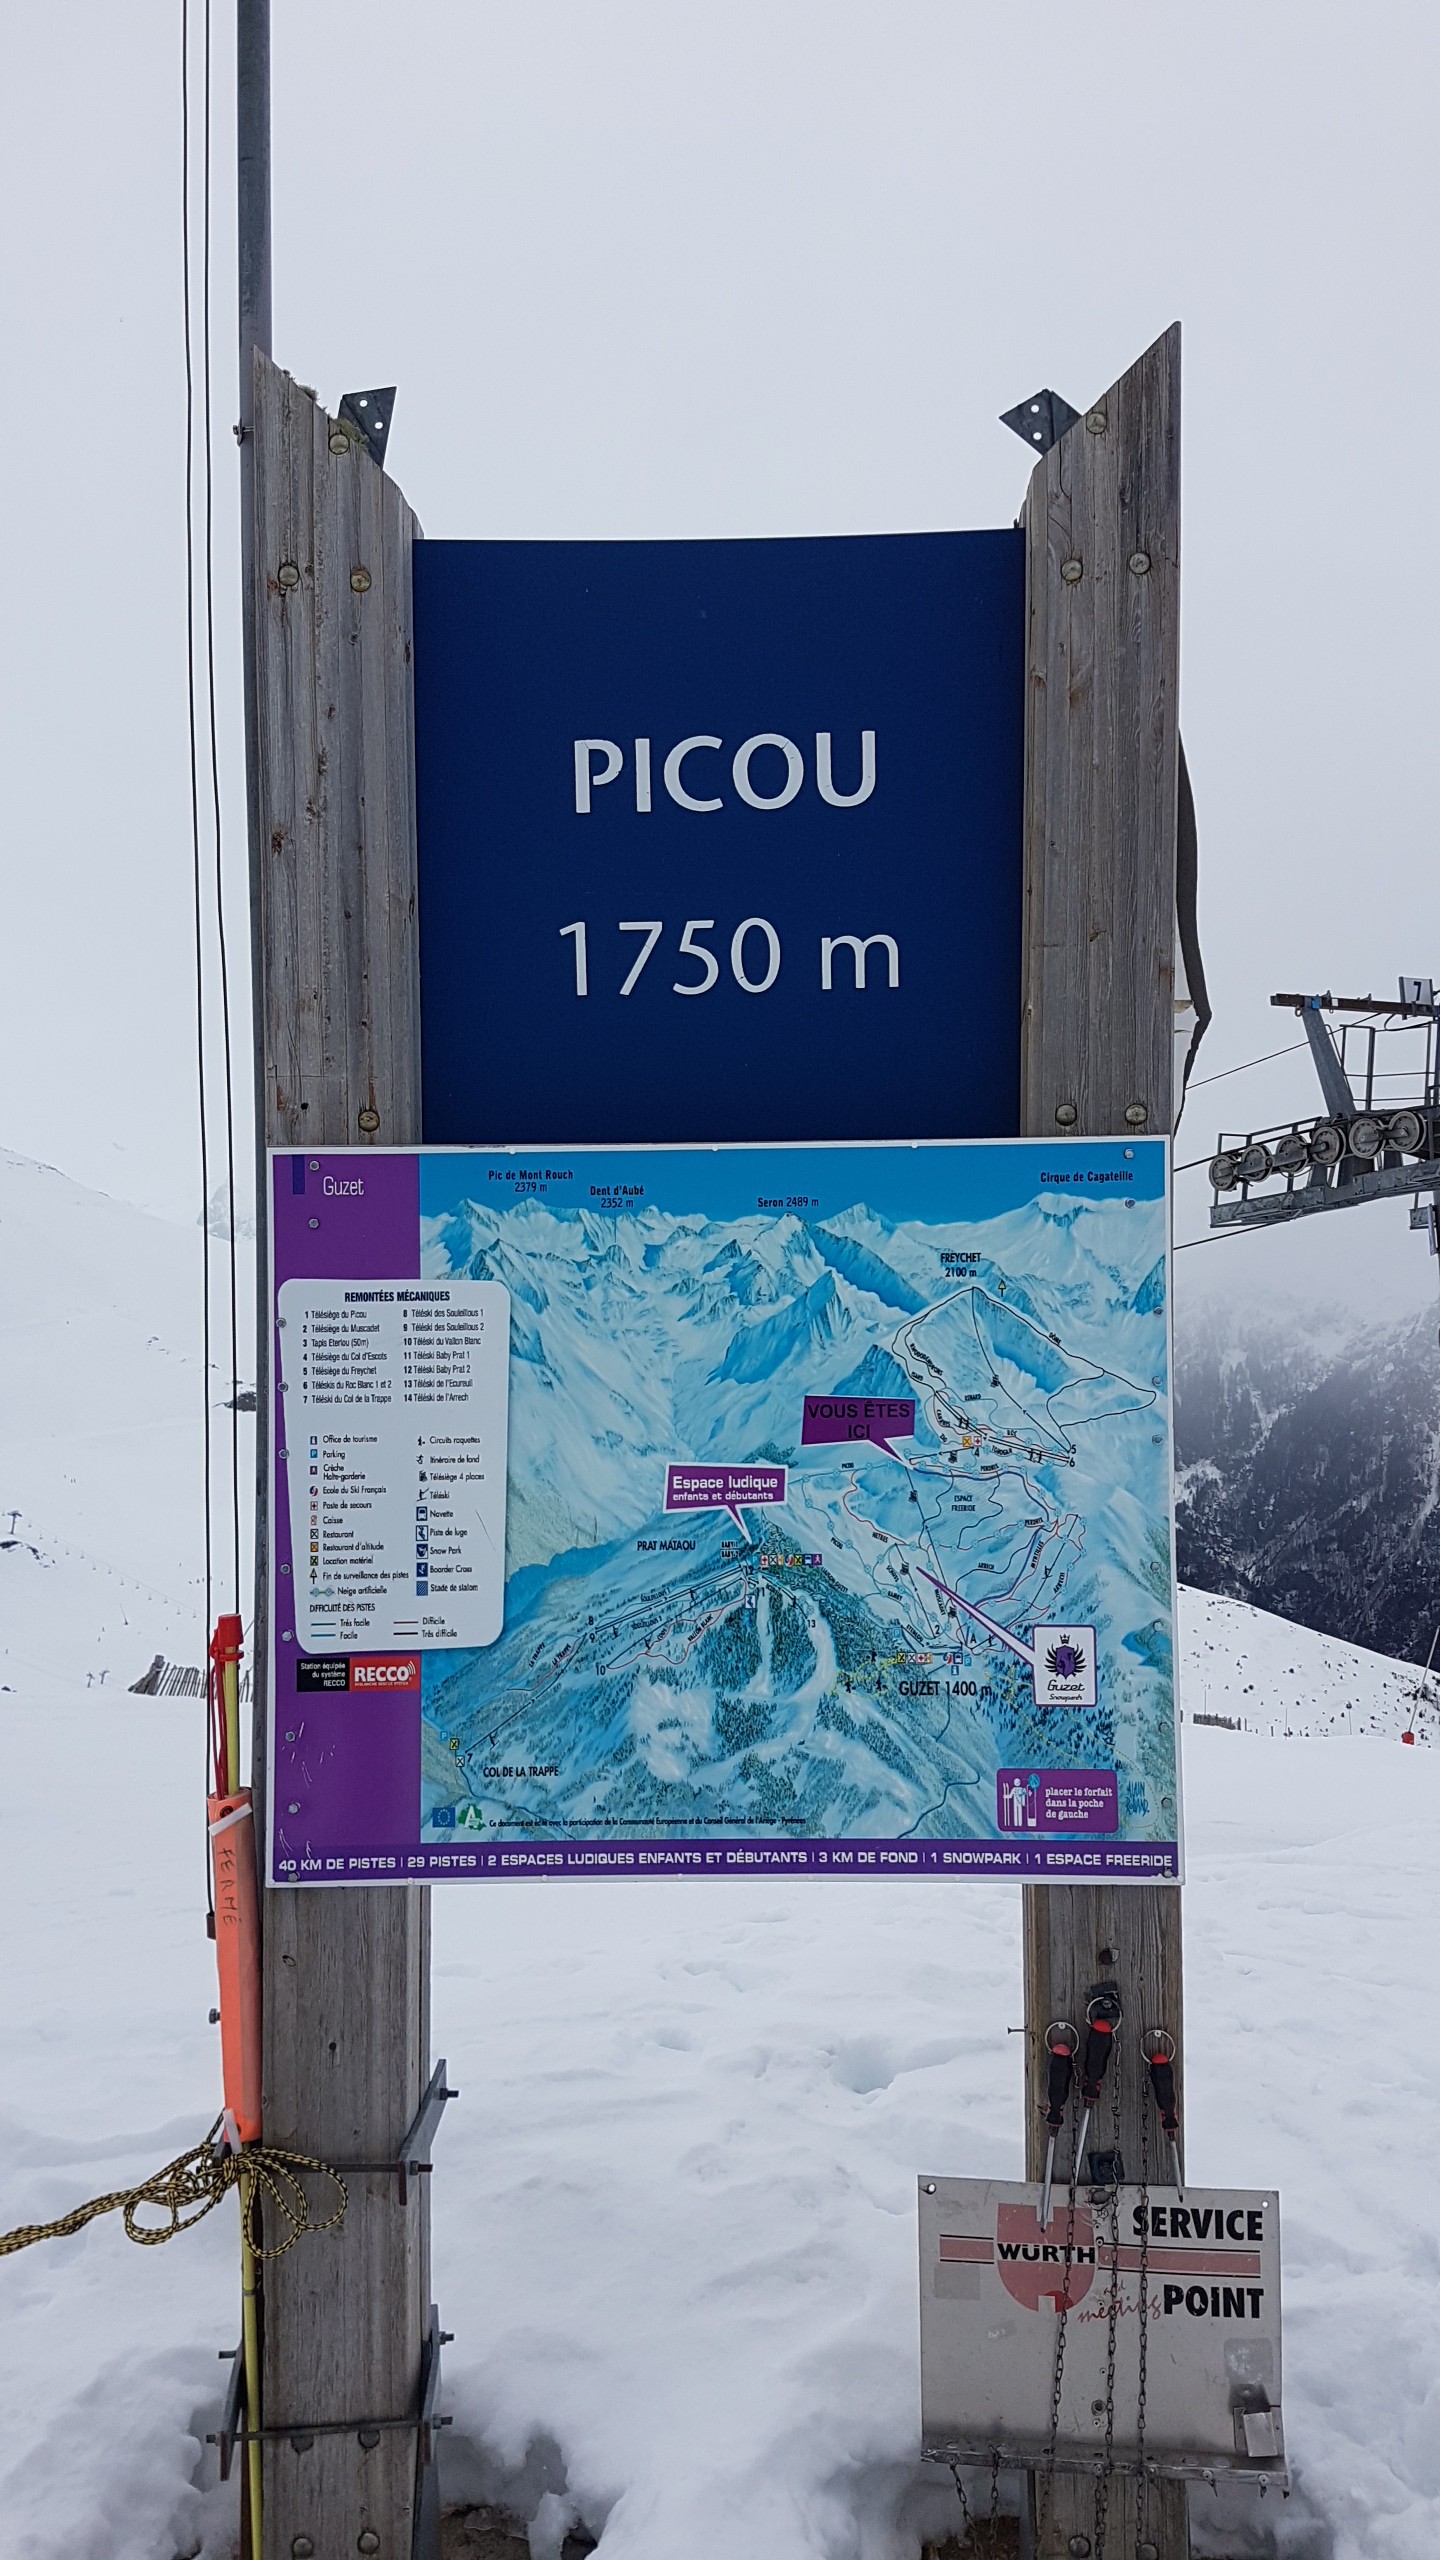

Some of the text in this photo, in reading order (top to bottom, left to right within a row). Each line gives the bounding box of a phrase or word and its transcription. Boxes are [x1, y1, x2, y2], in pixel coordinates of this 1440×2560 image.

[573, 730, 876, 814] PICOU
[559, 917, 900, 996] 1750 m
[1412, 981, 1422, 1002] 7
[488, 1169, 573, 1180] Pic de Mont Rouch
[1040, 1170, 1133, 1183] Cirque de Cagateille
[322, 1175, 365, 1197] Guzet
[514, 1182, 547, 1192] 2379 m
[590, 1184, 644, 1196] Dent d'Aubé
[601, 1197, 633, 1208] 2352 m
[757, 1196, 819, 1208] Seron 2489 m
[940, 1252, 981, 1264] FREYCHET
[945, 1267, 977, 1278] 2100 m
[344, 1289, 450, 1302] REMONTÉES MÉCANIQUES
[304, 1309, 367, 1320] 1 Télésiège du Picou
[302, 1323, 380, 1334] 2 Télésiège du Muscadet
[302, 1338, 308, 1347] 3
[311, 1338, 327, 1349] Tapis
[350, 1338, 369, 1348] (50m)
[403, 1337, 412, 1346] 10
[413, 1337, 435, 1346] Téléski
[436, 1337, 444, 1346] du
[302, 1353, 308, 1361] 4
[311, 1352, 340, 1363] Télésiège
[341, 1352, 349, 1361] du
[351, 1352, 361, 1361] Col
[403, 1351, 411, 1360] 11
[413, 1351, 435, 1360] Téléski
[436, 1350, 451, 1361] Baby
[452, 1351, 465, 1360] Prat
[302, 1365, 377, 1377] 5 Télésiège du Freychet
[807, 1400, 910, 1419] VOUS ÊTES
[848, 1424, 870, 1439] ICI
[322, 1434, 378, 1443] Office de tourisme
[429, 1435, 452, 1444] Circuits
[322, 1449, 346, 1460] Parking
[974, 1448, 980, 1457] 4
[1070, 1445, 1077, 1454] 5
[429, 1454, 480, 1464] Itinéraire de fond
[1069, 1459, 1076, 1468] 6
[429, 1472, 485, 1482] Télésiège 4 places
[672, 1474, 778, 1491] Espace ludique
[429, 1490, 450, 1499] Téléski
[672, 1490, 774, 1501] enfants et débutants
[429, 1509, 454, 1518] Navette
[322, 1516, 344, 1525] Caisse
[322, 1530, 354, 1538] Restaurant
[429, 1546, 462, 1555] Snow Park
[637, 1539, 696, 1551] PRAT MATAOU
[429, 1564, 473, 1573] Boarder Cross
[430, 1583, 478, 1592] Stade de slalom
[422, 1616, 446, 1626] Difficile
[435, 1628, 458, 1638] difficile
[934, 1624, 940, 1635] 2
[300, 1662, 346, 1671] Station équipée
[595, 1662, 606, 1676] 10
[321, 1671, 346, 1680] système
[354, 1666, 410, 1682] RECCO
[323, 1679, 346, 1687] RECCO
[900, 1680, 993, 1696] GUZET 1400 m
[1047, 1678, 1086, 1692] Guzet
[466, 1753, 473, 1763] 7
[483, 1765, 559, 1778] COL DE LA TRAPPE
[1045, 1787, 1113, 1798] placer le forfait
[1045, 1799, 1104, 1810] dans la poche
[1045, 1810, 1089, 1821] de gauche
[407, 1855, 476, 1868] 29 PISTES
[488, 1848, 808, 1867] 2 ESPACES LUDIQUES ENFANTS ET DÉBUTANTS
[818, 1851, 919, 1864] 3 KM DE FOND
[930, 1852, 1021, 1865] 1 SNOWPARK
[1034, 1853, 1172, 1867] 1 ESPACE FREERIDE
[278, 1857, 396, 1871] 40 KM DE PISTES
[217, 1847, 242, 1926] FERMÉ
[1132, 2206, 1264, 2241] SERVICE
[997, 2243, 1095, 2264] WÜRTH
[1103, 2279, 1126, 2296] ad
[1163, 2284, 1264, 2319] POINT
